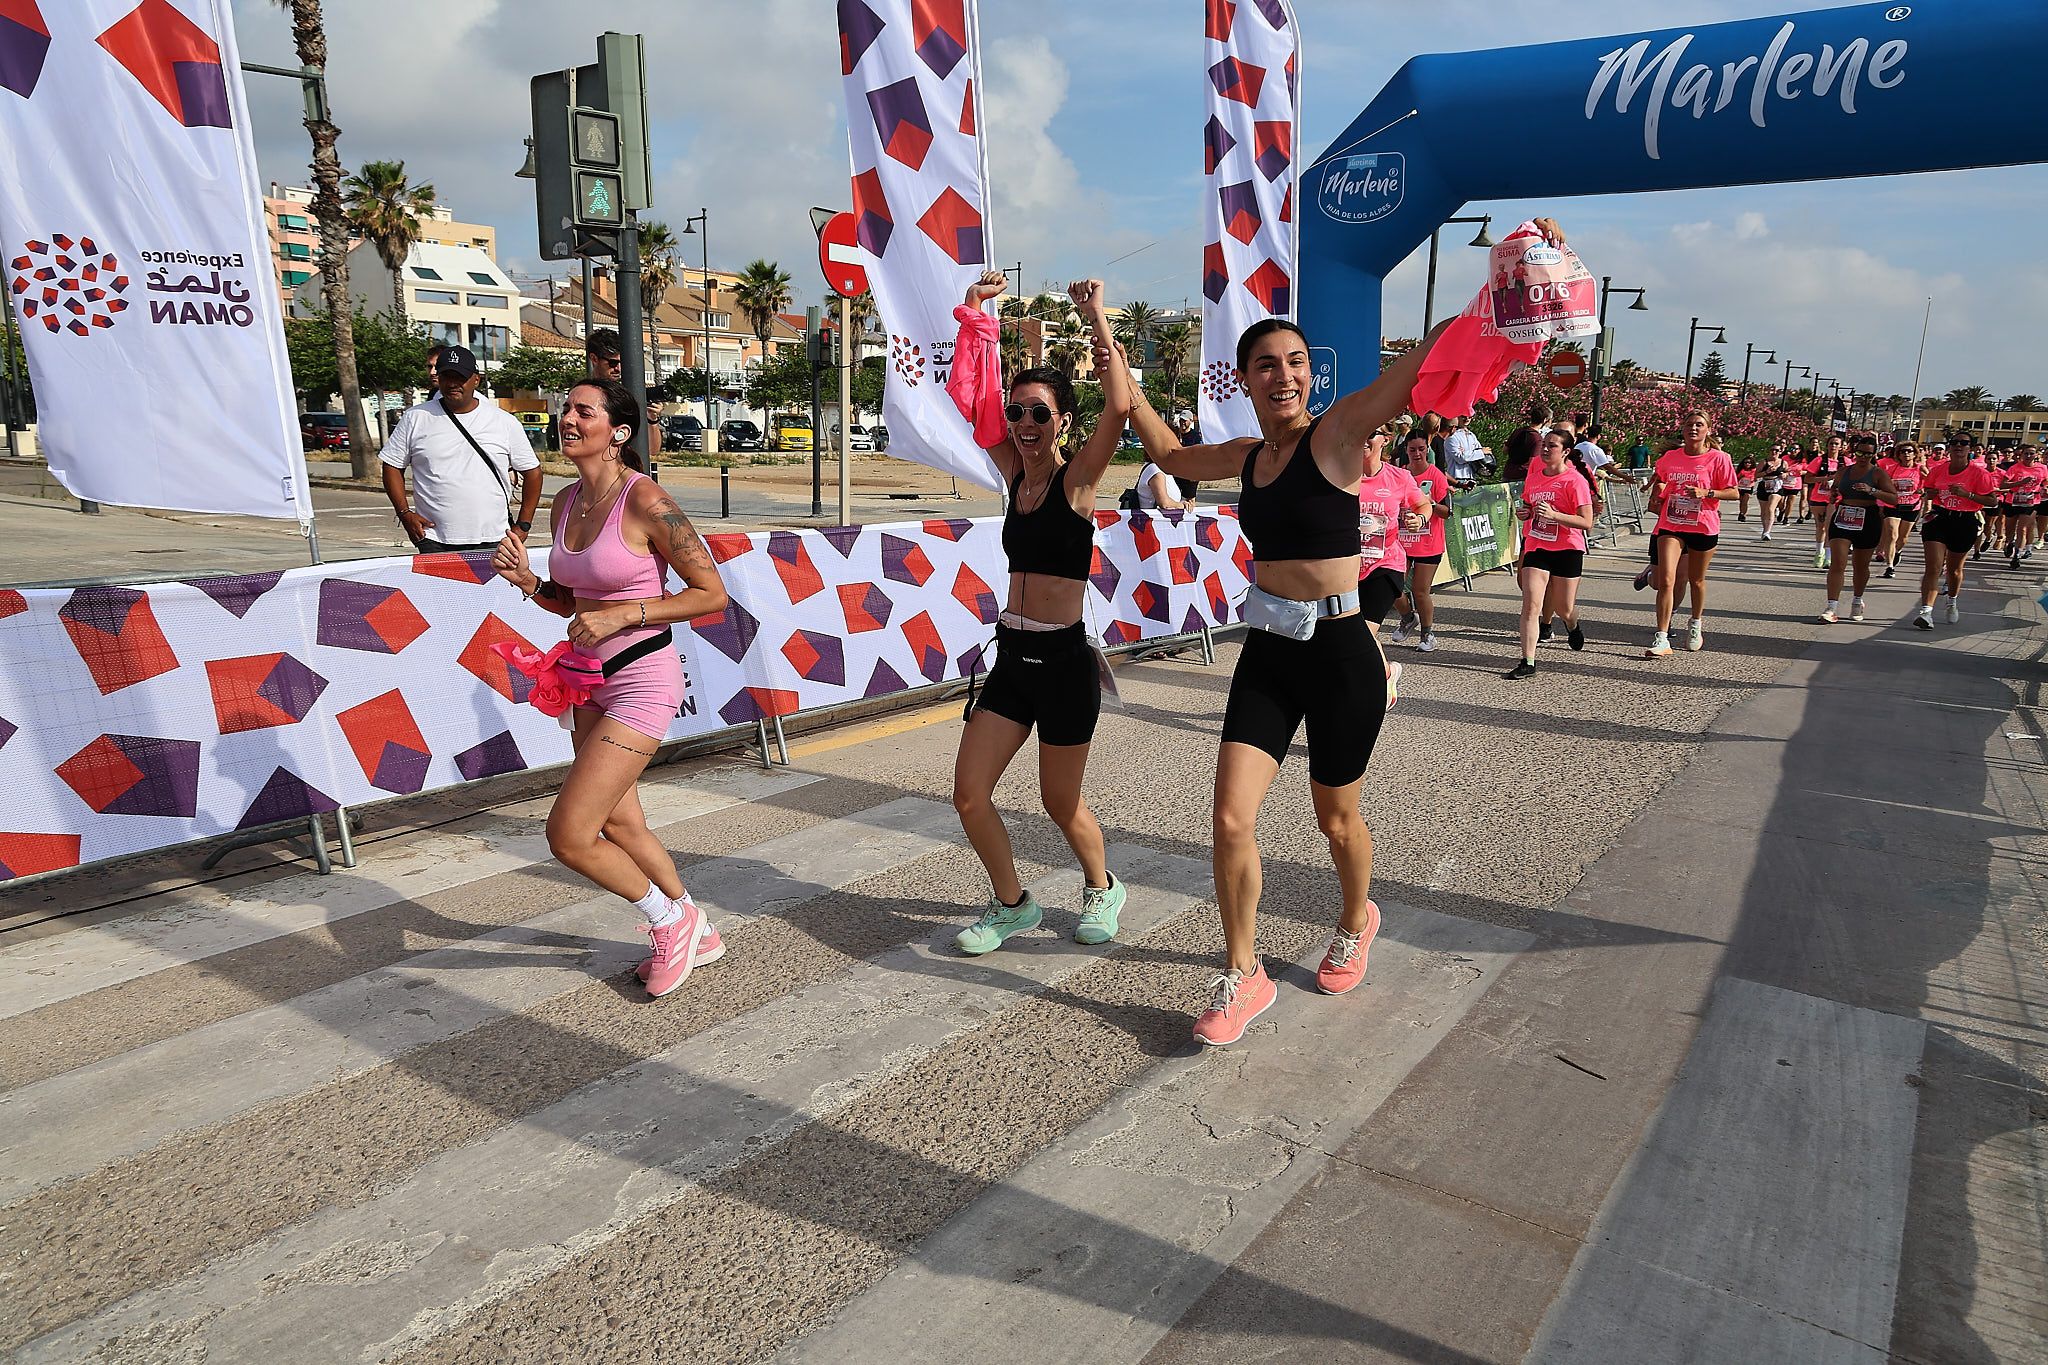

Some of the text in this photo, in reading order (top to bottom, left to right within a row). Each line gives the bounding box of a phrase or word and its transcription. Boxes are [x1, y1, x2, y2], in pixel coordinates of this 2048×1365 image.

[1585, 21, 1908, 160] Marlene
[1324, 169, 1398, 205] Marlene
[1326, 203, 1340, 216] HIJA
[1341, 211, 1352, 219] DE
[1369, 202, 1392, 218] ALPES
[1497, 248, 1520, 259] SUMA
[1528, 282, 1571, 303] 016
[1542, 301, 1564, 313] 3326
[1505, 316, 1531, 326] CARRERA
[1531, 315, 1540, 323] DE
[1508, 327, 1544, 339] OYSHO
[1309, 401, 1324, 414] PES
[1360, 501, 1385, 514] RERA
[1360, 533, 1371, 541] 16
